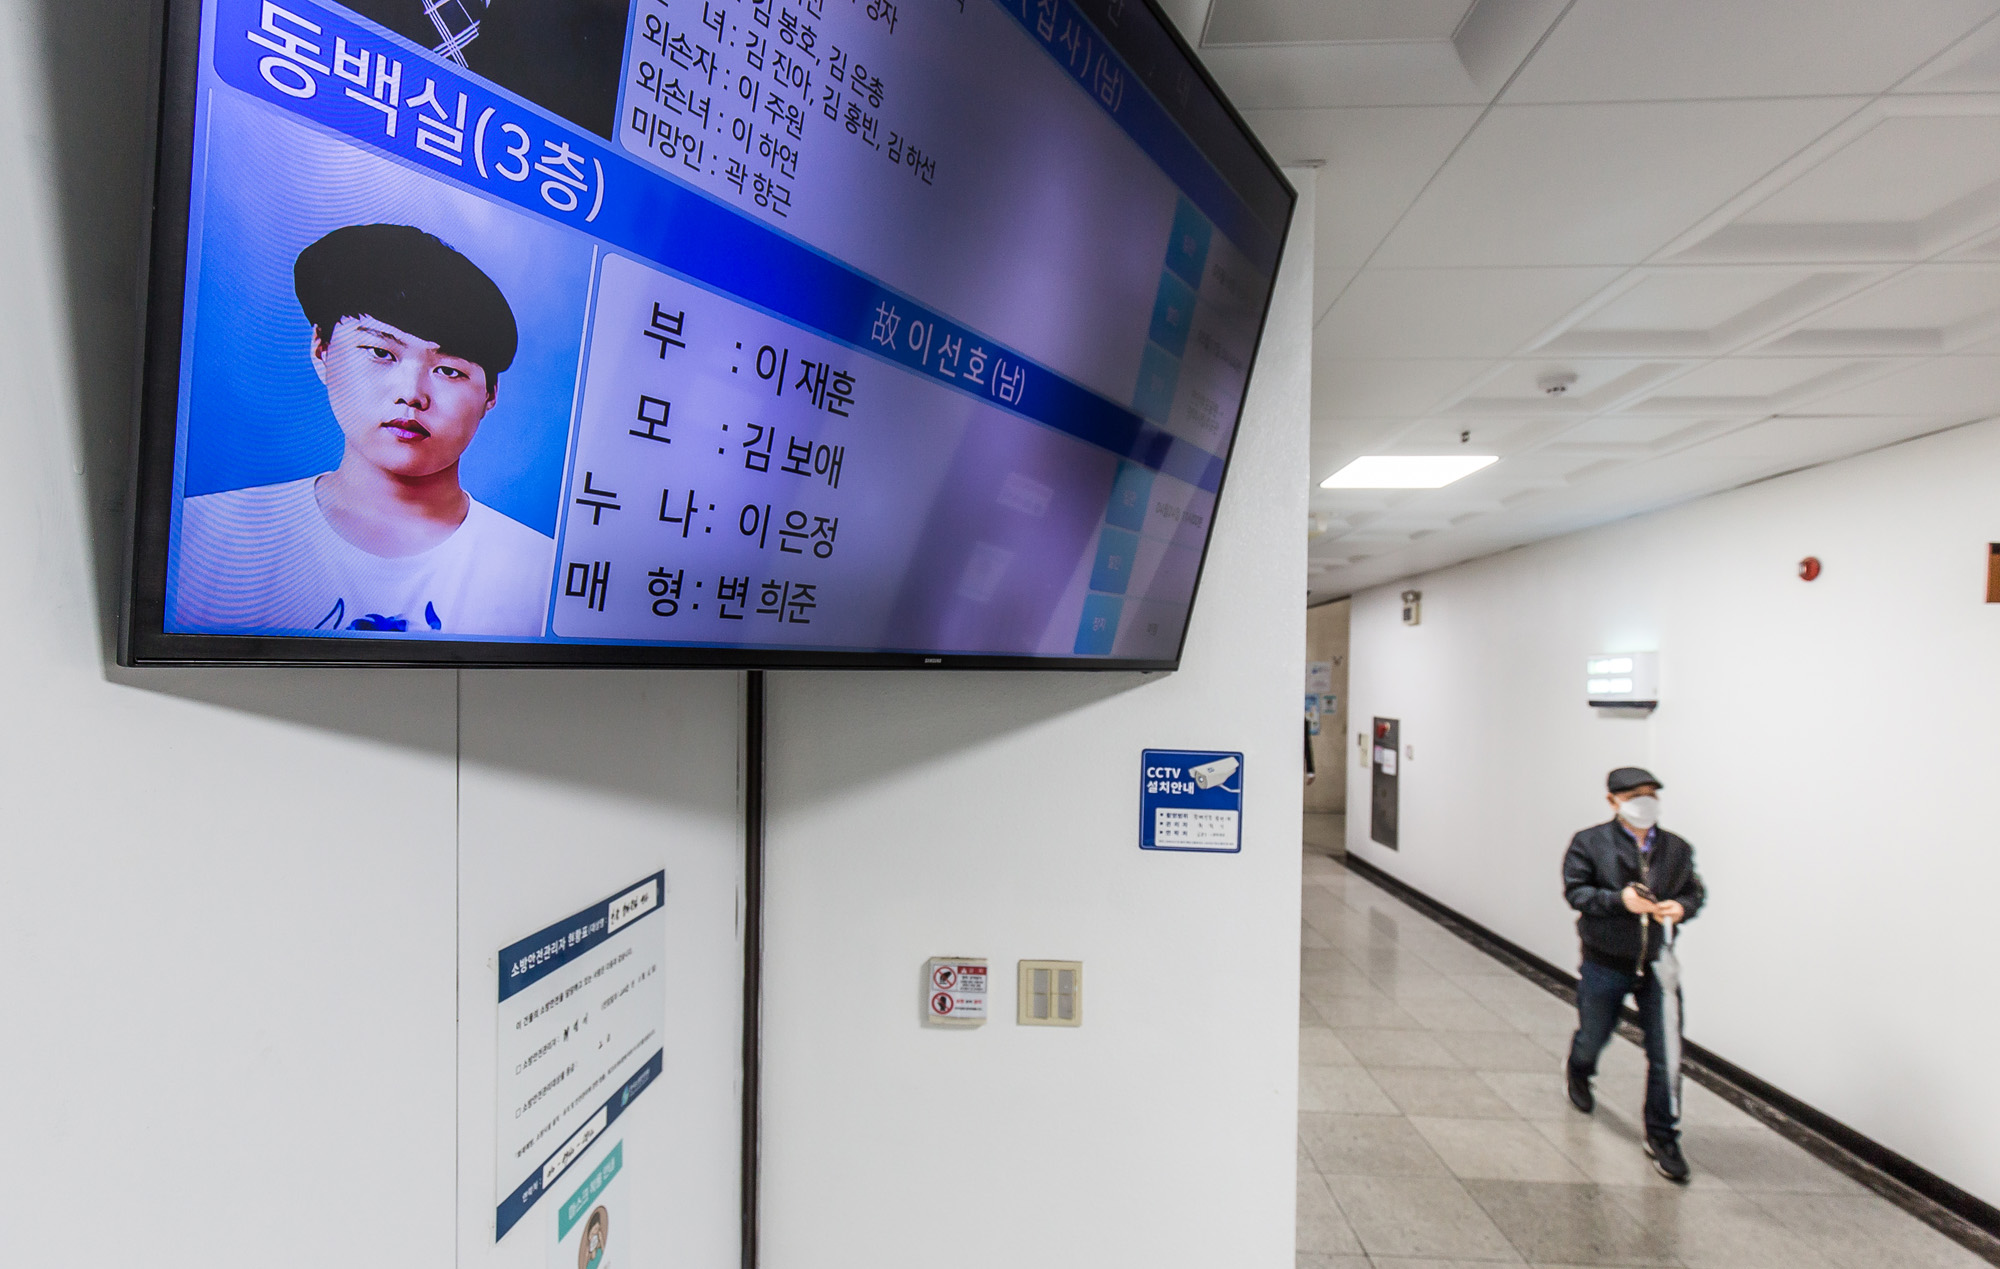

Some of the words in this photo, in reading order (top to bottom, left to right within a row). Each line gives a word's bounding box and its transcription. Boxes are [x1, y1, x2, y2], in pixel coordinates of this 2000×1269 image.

[247, 0, 604, 222] 동백실(3층)
[642, 14, 718, 85] 외손자
[738, 75, 760, 113] 이
[764, 92, 805, 141] 주원
[746, 30, 766, 71] 김
[823, 85, 841, 121] 김
[888, 131, 903, 164] 김
[906, 145, 936, 186] 하선
[829, 45, 847, 82] 김
[631, 106, 704, 173] 미망인
[725, 157, 748, 195] 곽
[753, 172, 792, 218] 향근
[636, 61, 711, 130] 외손녀
[732, 117, 753, 154] 이
[759, 133, 798, 180] 하연
[643, 302, 686, 360] 부
[756, 345, 788, 396] 이
[795, 359, 856, 418] 재훈
[629, 394, 671, 444] 모
[743, 423, 775, 473] 김
[781, 436, 845, 489] 보애
[576, 471, 621, 525] 누
[739, 504, 771, 549] 이
[779, 510, 838, 559] 은정
[565, 561, 611, 612] 매
[717, 575, 749, 620] 변
[756, 579, 817, 624] 희준
[1147, 767, 1181, 779] CCTV
[1147, 780, 1195, 795] 설치안내
